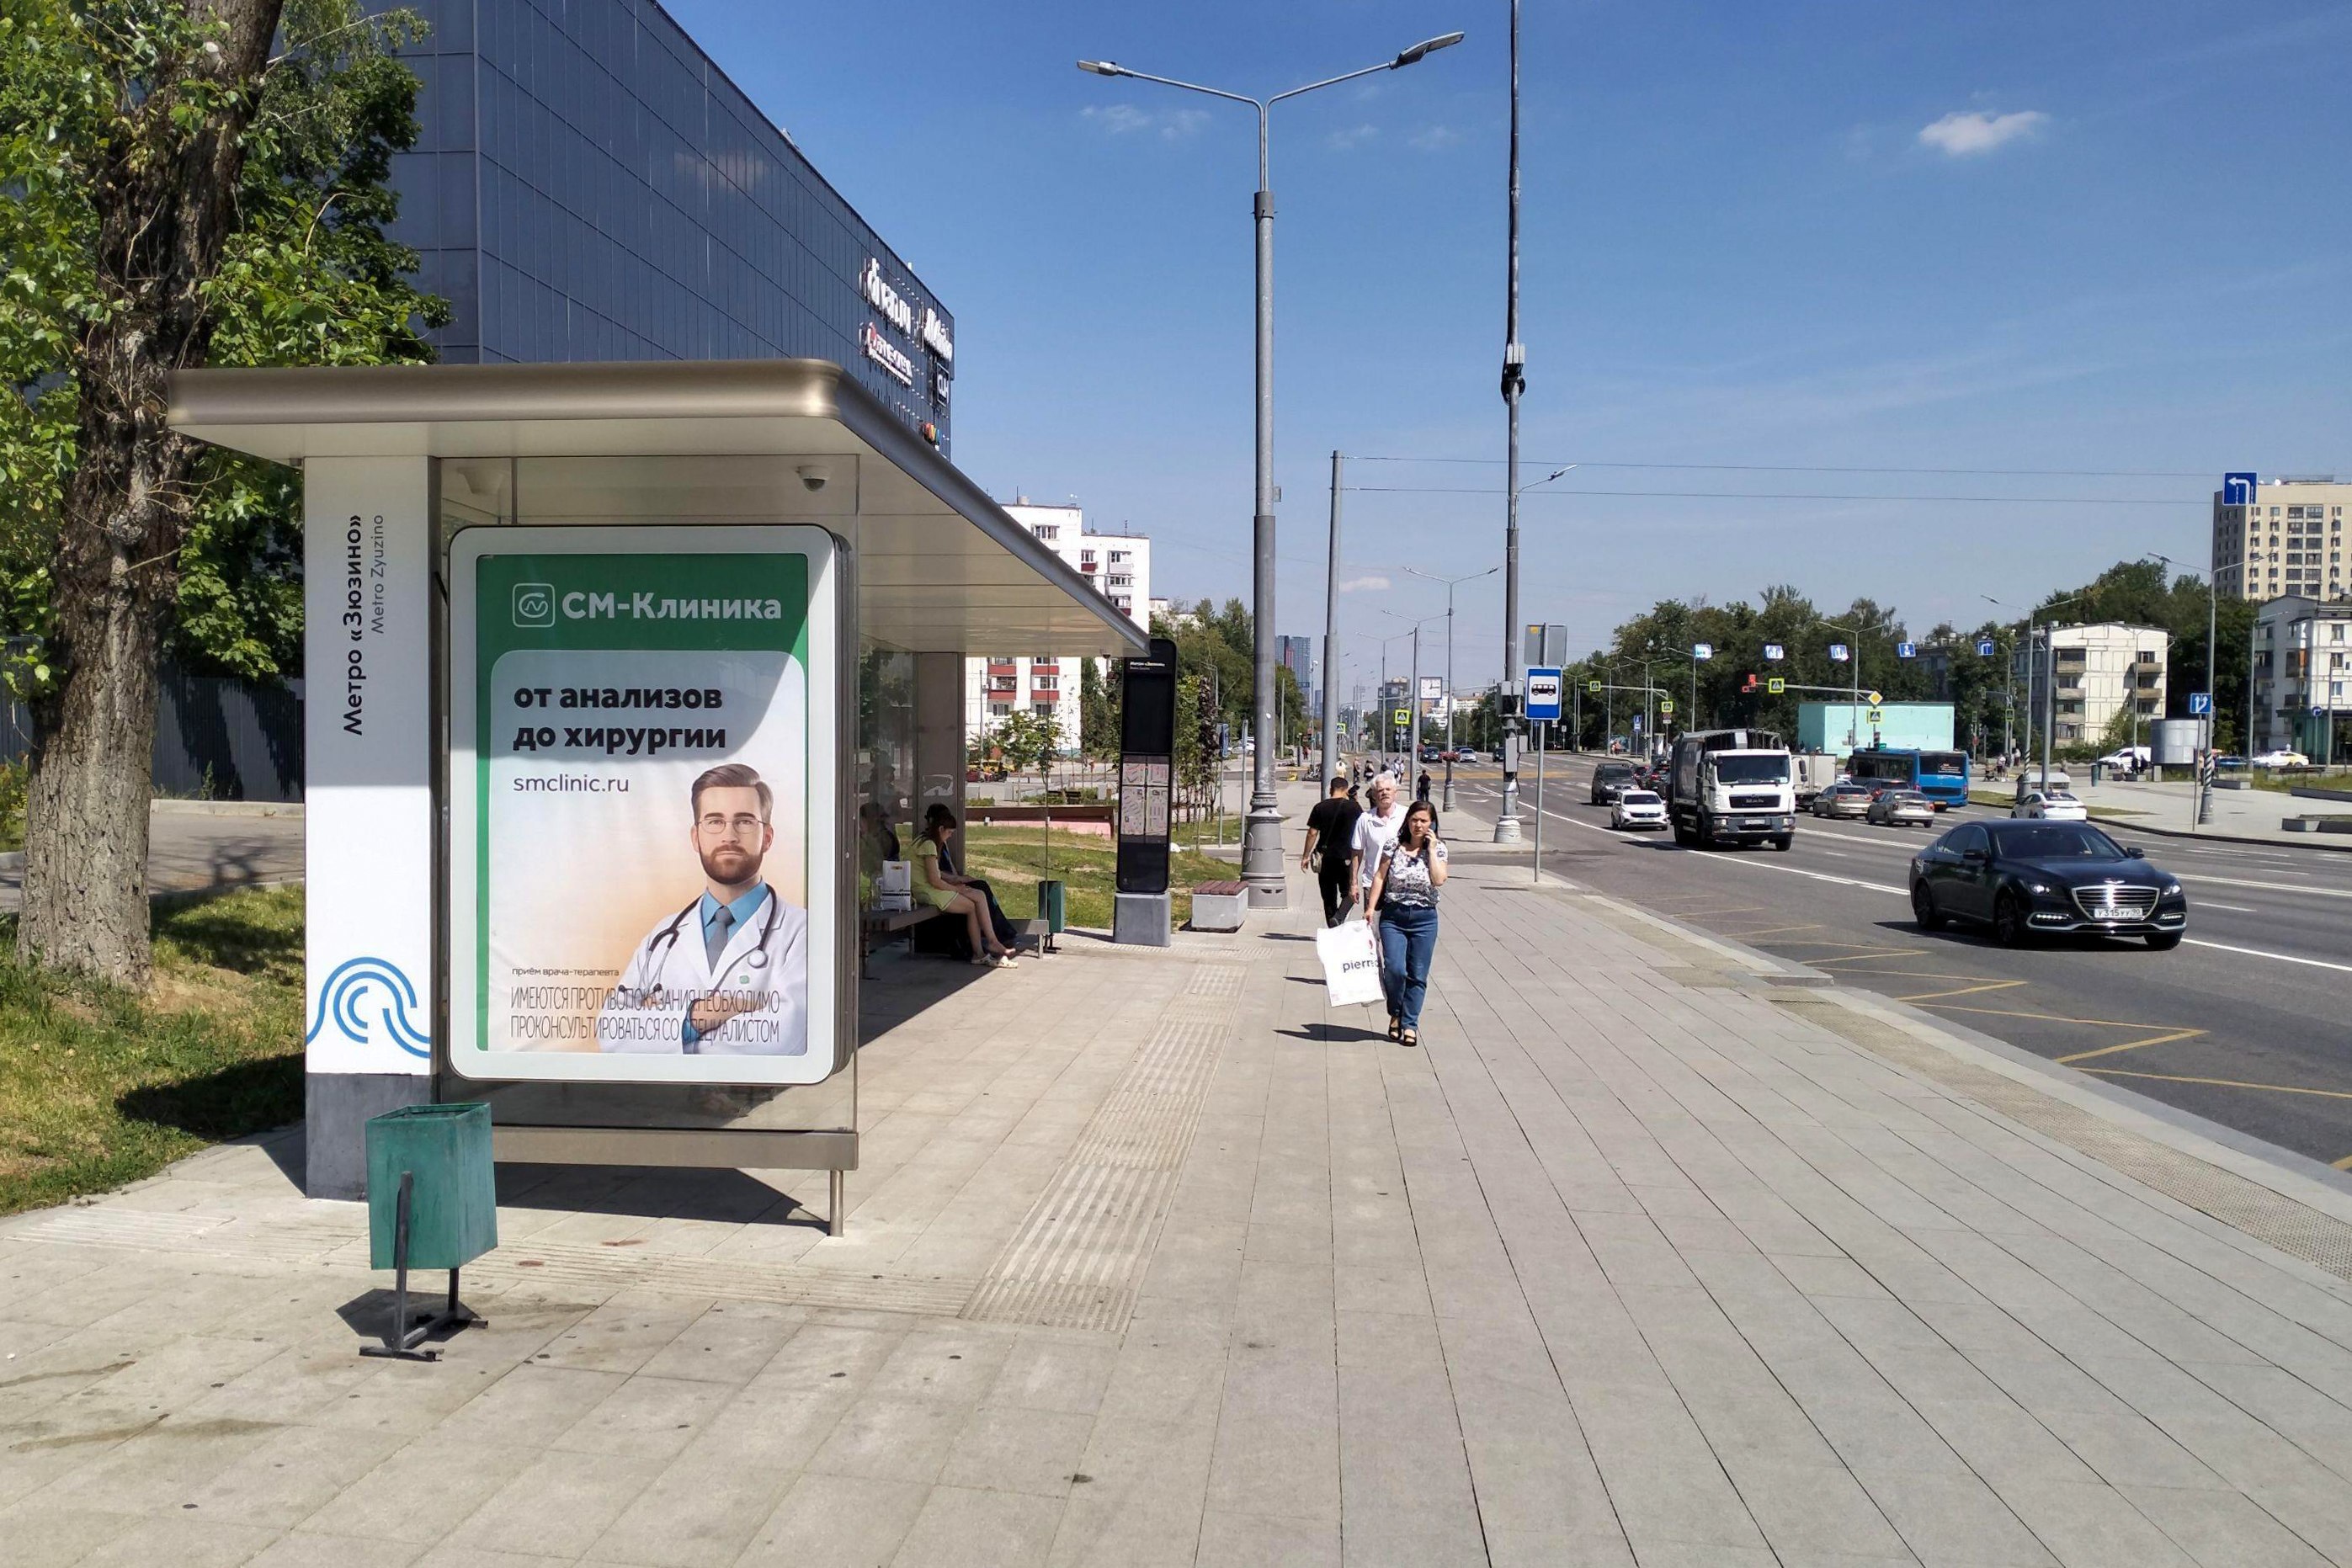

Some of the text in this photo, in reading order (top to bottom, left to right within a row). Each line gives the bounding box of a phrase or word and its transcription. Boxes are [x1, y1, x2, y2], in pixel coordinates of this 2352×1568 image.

[370, 514, 386, 634] Metro Zyuzino
[561, 591, 782, 620] СМ-Клиника
[343, 514, 366, 736] Метро «Зюзино»
[514, 687, 722, 710] от анализов
[513, 726, 726, 756] до хирургии
[513, 773, 630, 793] smclinic.ru
[512, 967, 620, 977] приём врача-терапевта
[511, 986, 569, 1010] ИМЕЮТСЯ
[699, 988, 780, 1017] НЕОБХОДИМО
[511, 1015, 660, 1040] ПРОКОНСУЛЬТИРОВАТЬСЯ
[662, 1017, 679, 1041] СО
